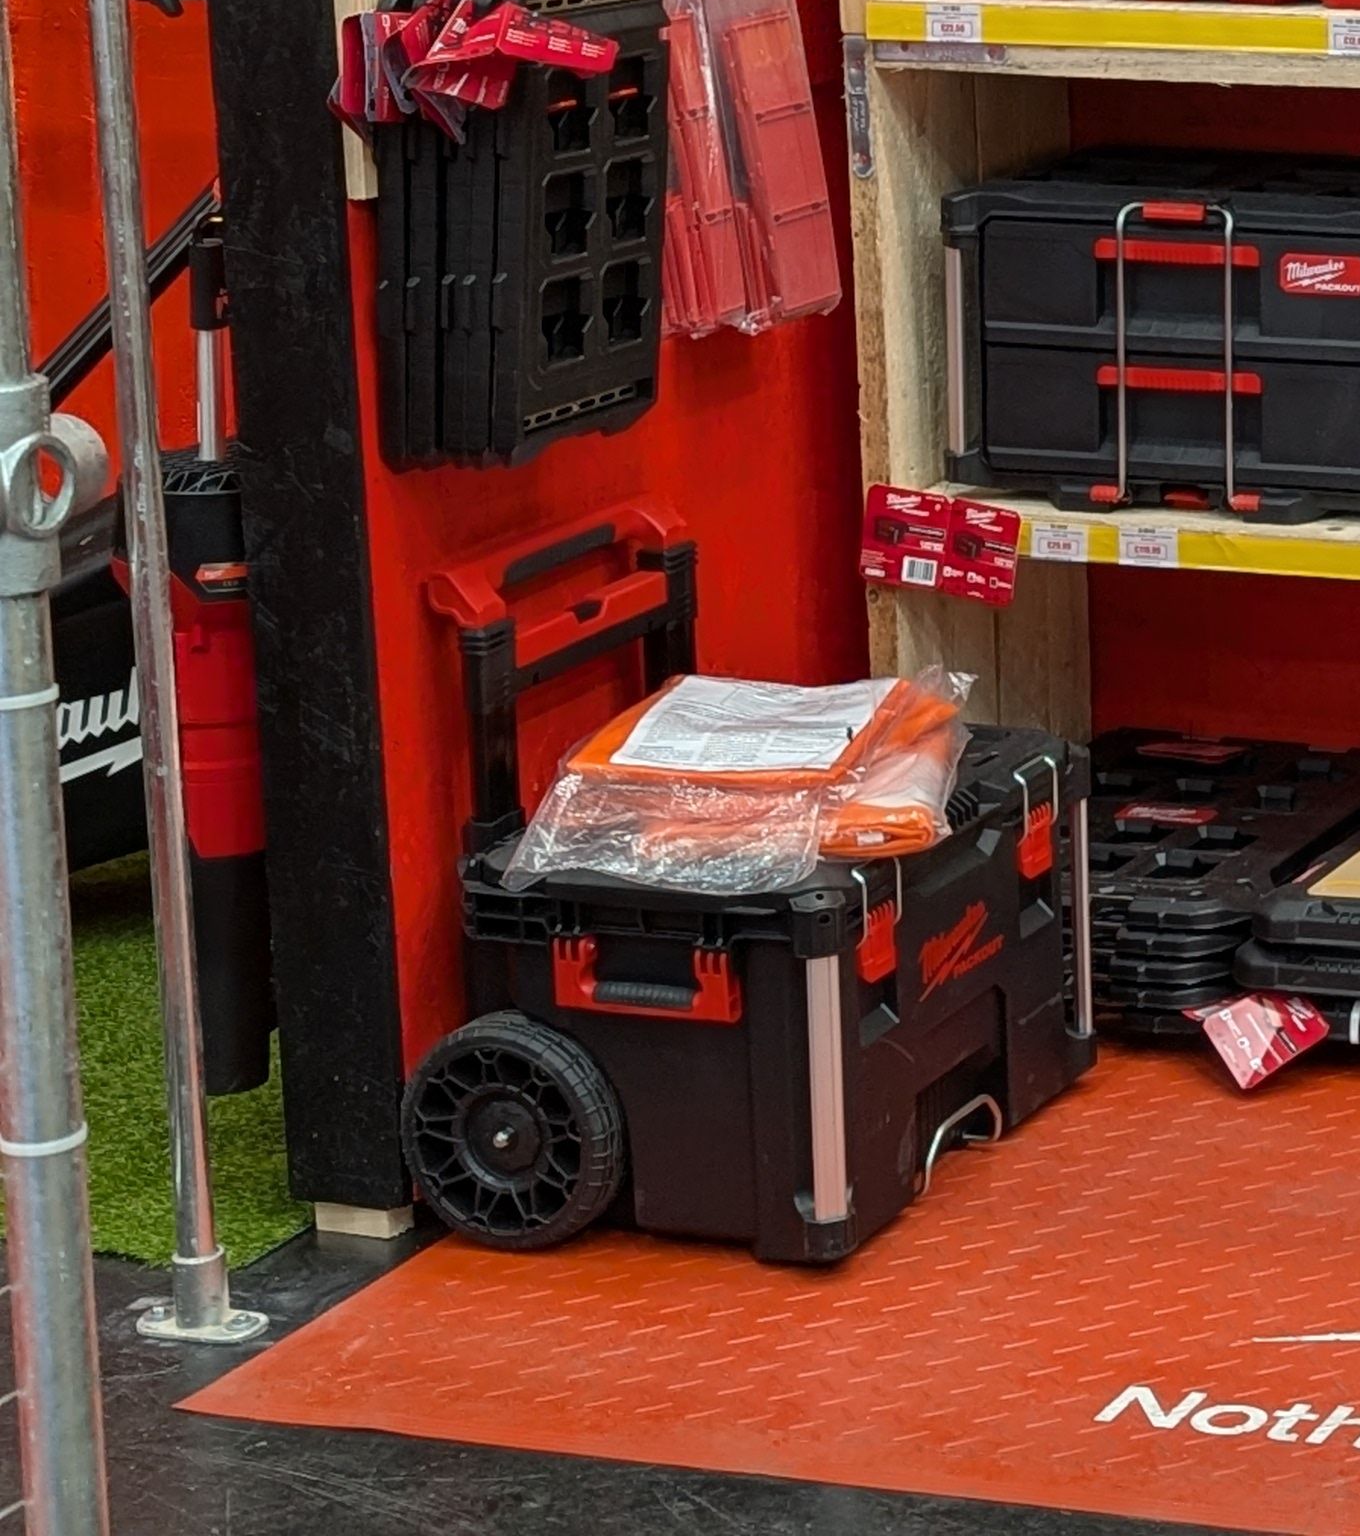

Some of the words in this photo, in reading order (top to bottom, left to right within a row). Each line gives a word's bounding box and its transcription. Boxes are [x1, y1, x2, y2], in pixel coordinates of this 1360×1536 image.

[1285, 261, 1345, 282] Milwaukee
[920, 901, 986, 984] Milwaukee
[952, 934, 1005, 978] PACKOUT
